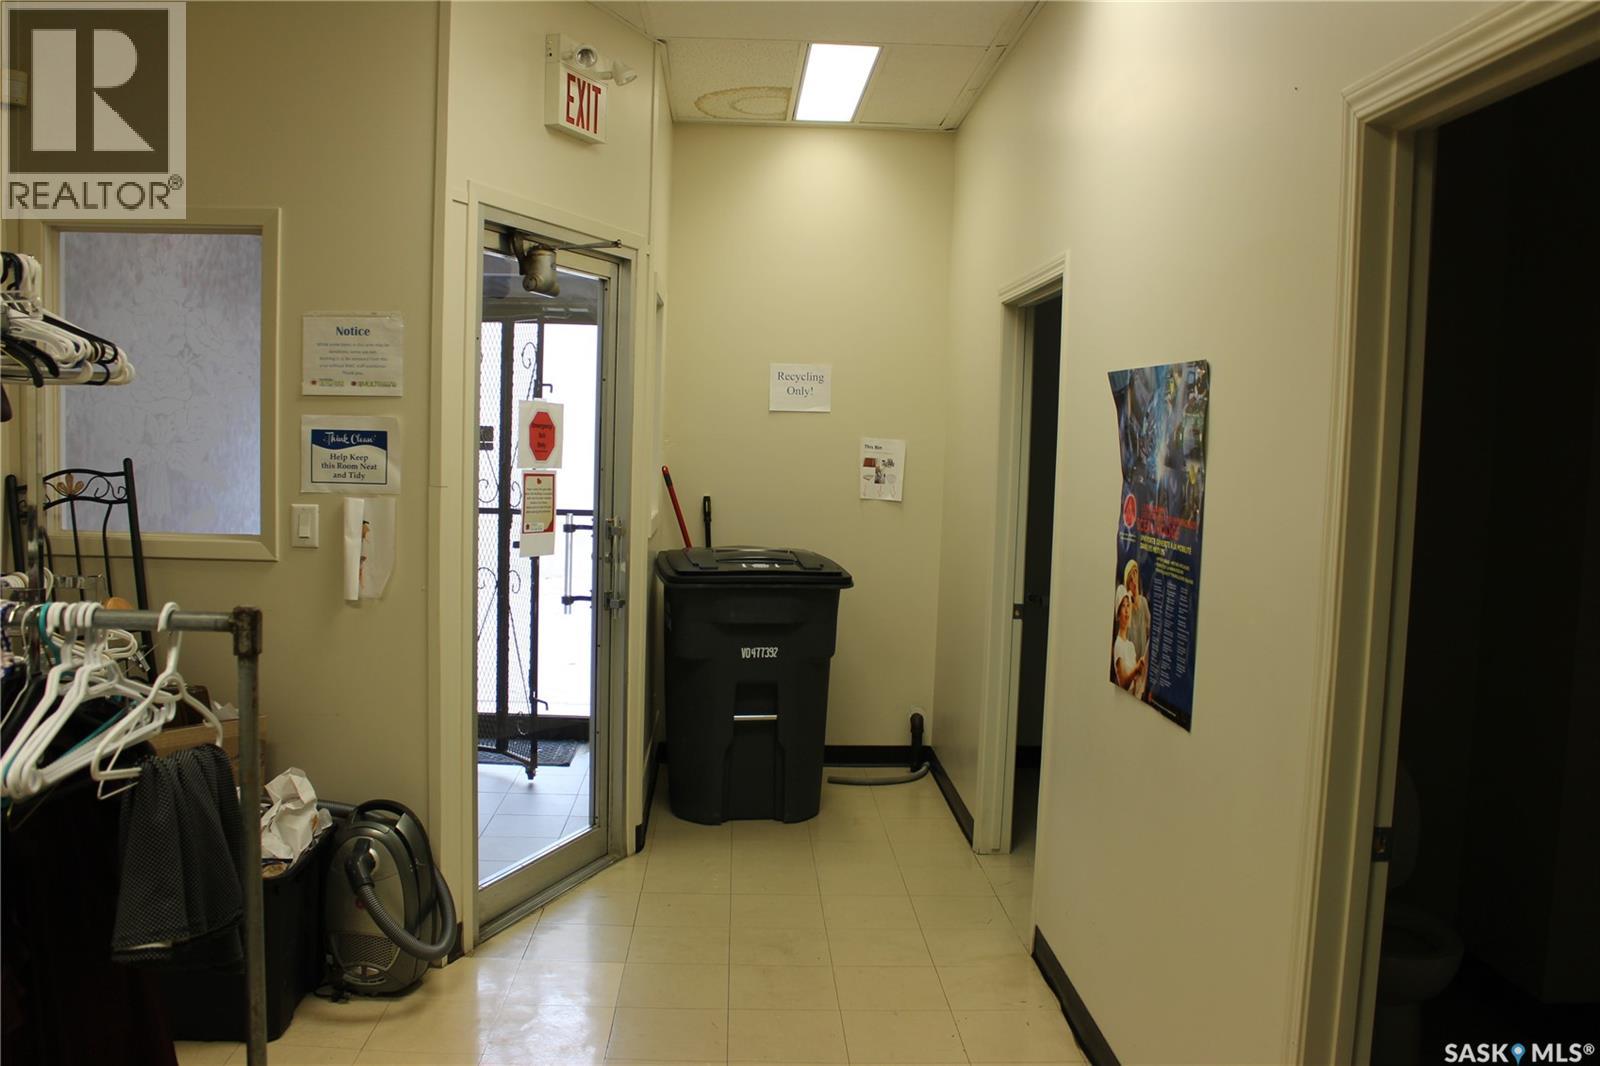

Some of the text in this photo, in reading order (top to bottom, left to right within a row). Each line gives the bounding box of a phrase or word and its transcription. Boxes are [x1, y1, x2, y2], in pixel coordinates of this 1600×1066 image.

[566, 72, 602, 134] EXIT
[336, 326, 371, 337] Notice
[777, 371, 825, 384] Recycling
[786, 386, 814, 398] Only!
[323, 431, 374, 445] Think Clean
[330, 453, 369, 463] Help Keep
[321, 462, 377, 471] this Room Neat
[332, 471, 366, 480] and Tidy
